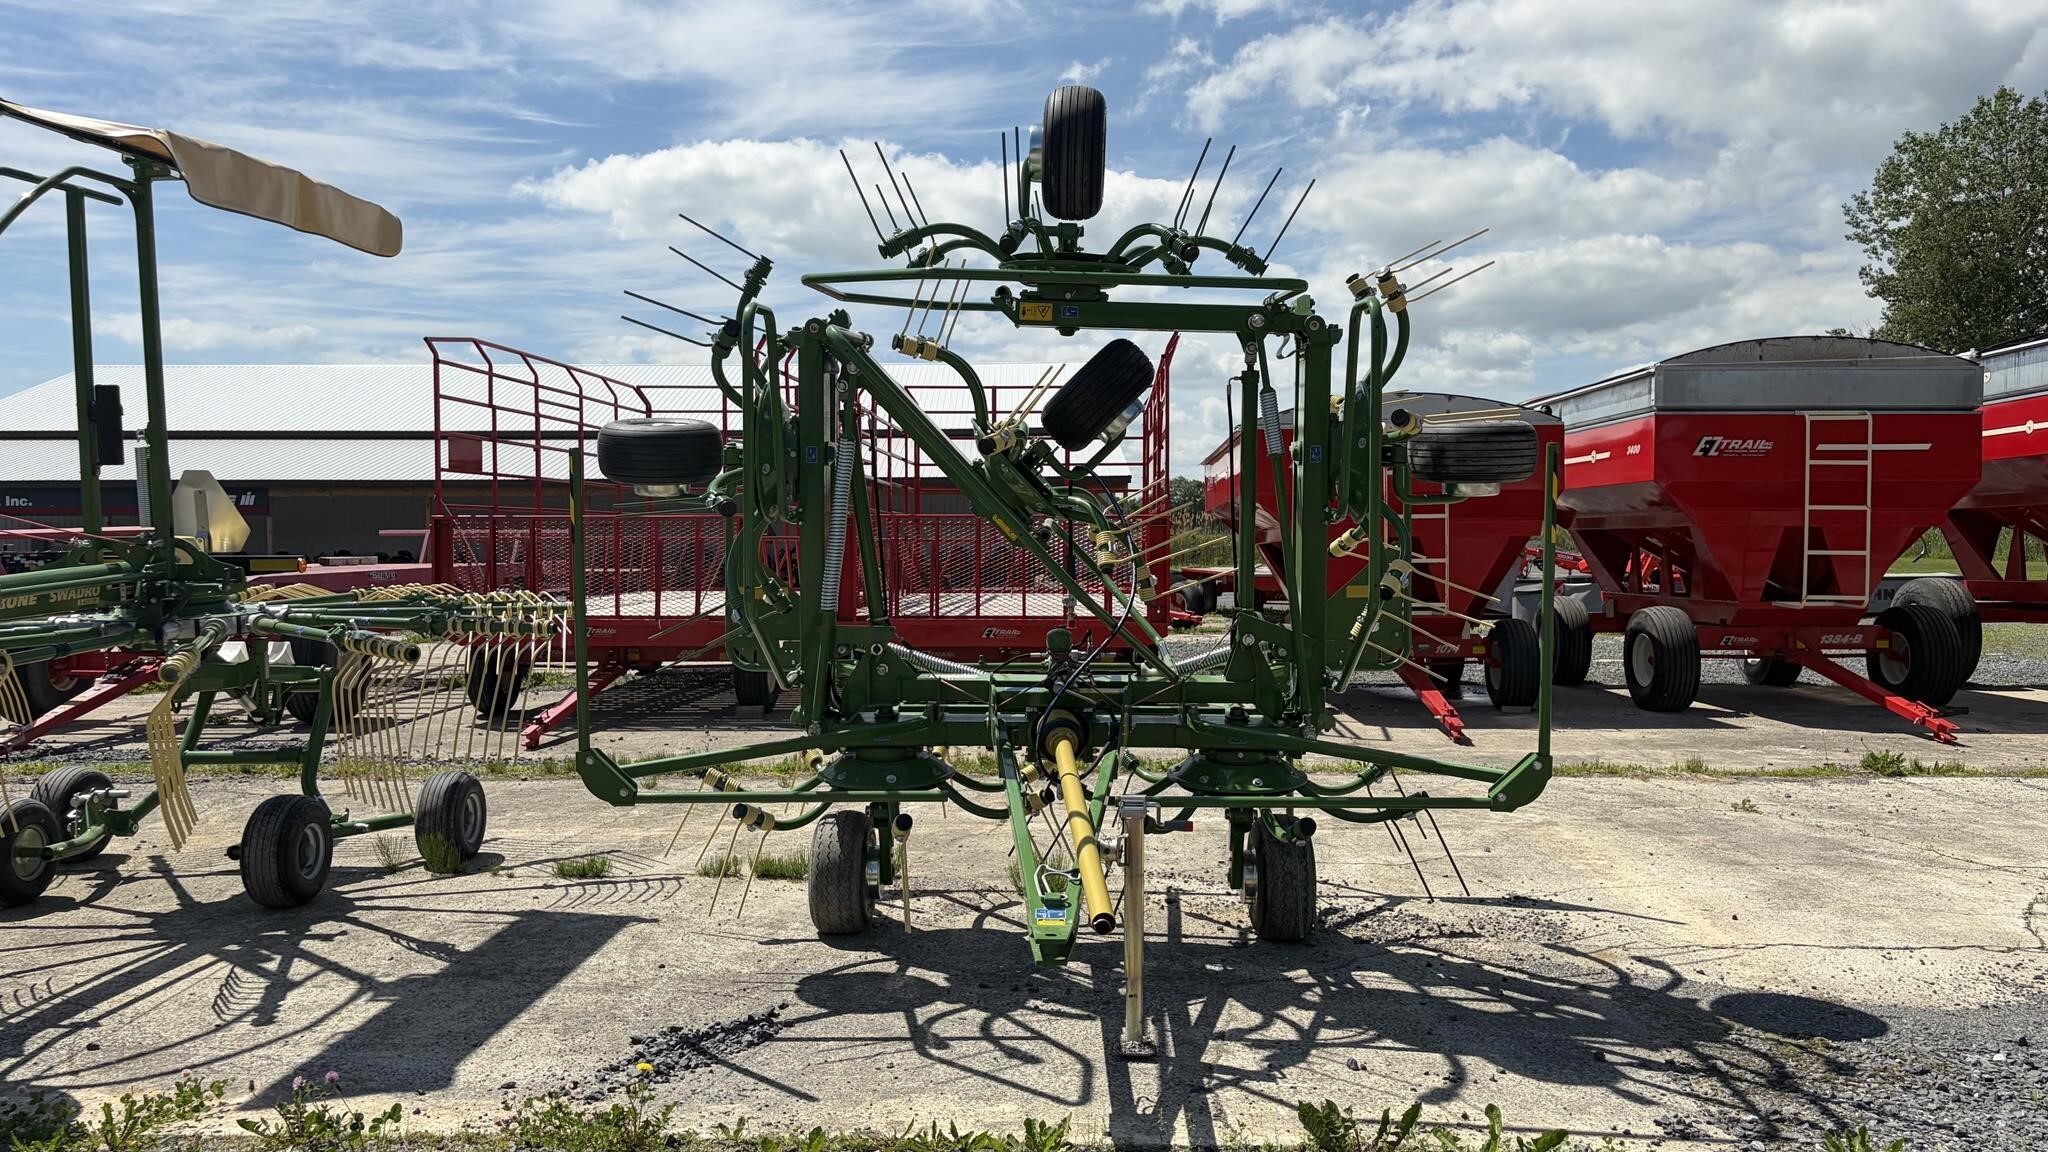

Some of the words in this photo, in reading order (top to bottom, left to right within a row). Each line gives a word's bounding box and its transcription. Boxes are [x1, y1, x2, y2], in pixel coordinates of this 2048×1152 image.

[1692, 436, 1723, 456] EZ
[5, 495, 33, 507] Inc.
[49, 586, 100, 602] SWADRO
[1821, 634, 1863, 644] 1384-B
